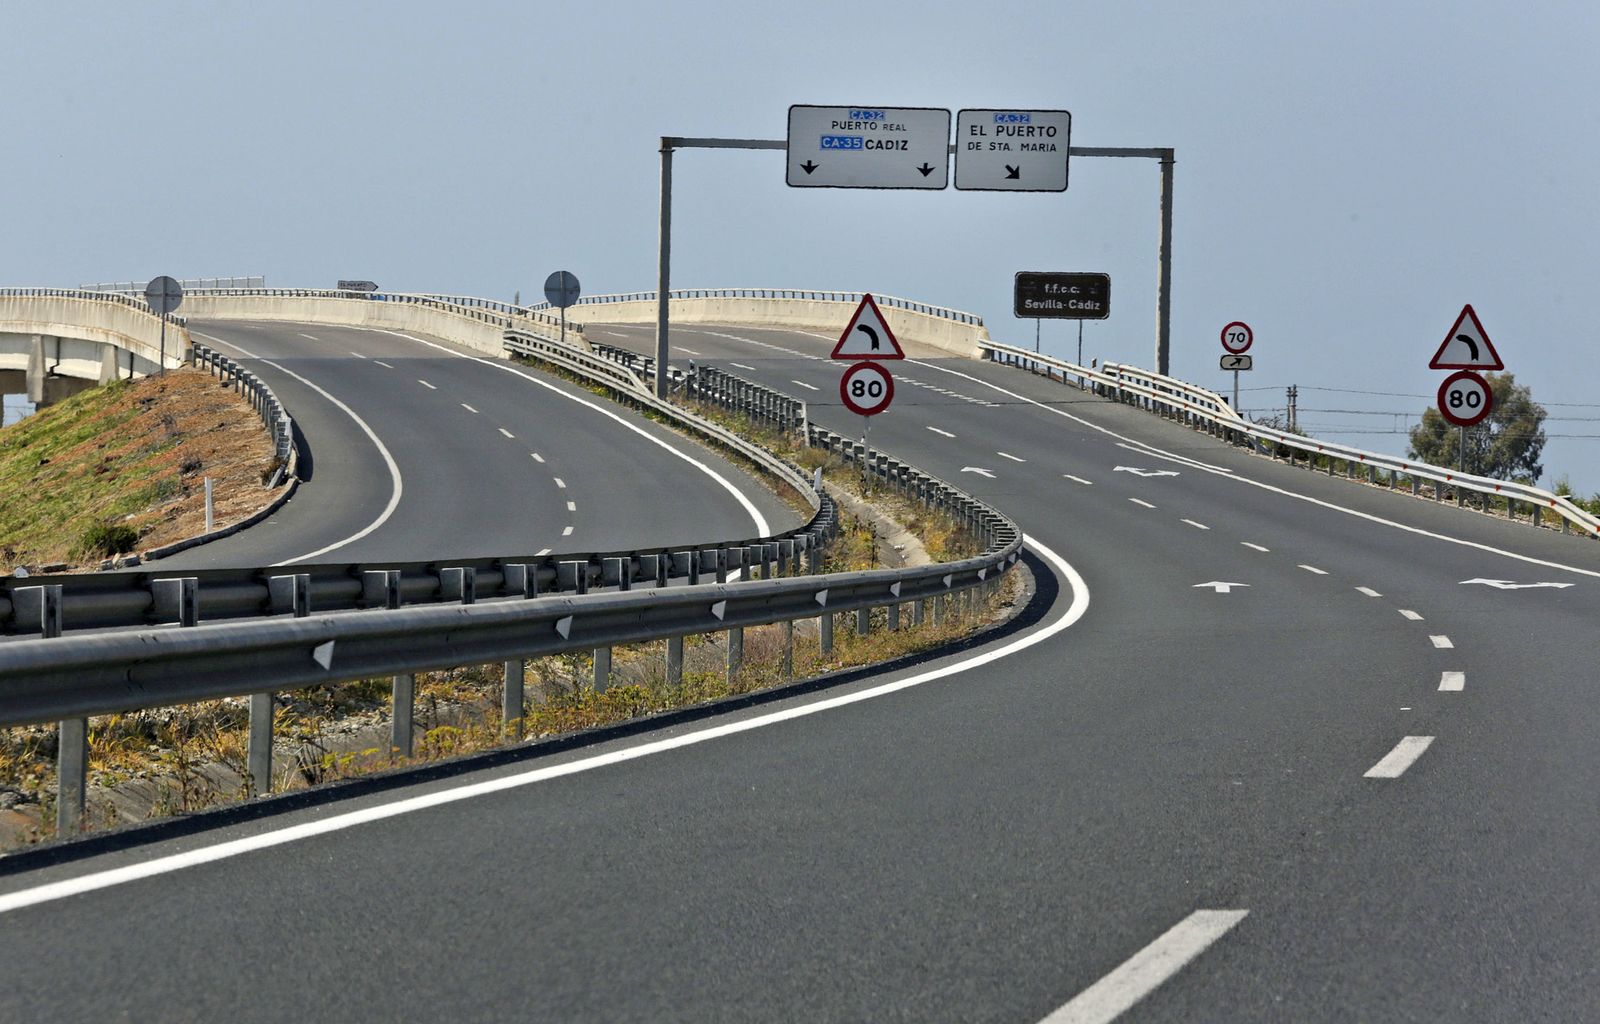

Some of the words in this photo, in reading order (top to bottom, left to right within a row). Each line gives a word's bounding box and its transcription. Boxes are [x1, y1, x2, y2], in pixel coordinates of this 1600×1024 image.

[850, 110, 884, 120] CA-32
[995, 114, 1030, 123] CA-32
[831, 120, 878, 131] PUERTO
[883, 123, 907, 132] REAL
[970, 125, 987, 136] EL
[996, 125, 1057, 138] PUERTO
[822, 137, 861, 148] CA-35
[865, 139, 909, 151] CADIZ
[967, 141, 982, 151] DE
[989, 141, 1013, 152] STA.
[1020, 143, 1057, 153] MARIA
[1228, 332, 1246, 344] 70
[851, 379, 883, 398] 80
[1449, 389, 1481, 409] 80
